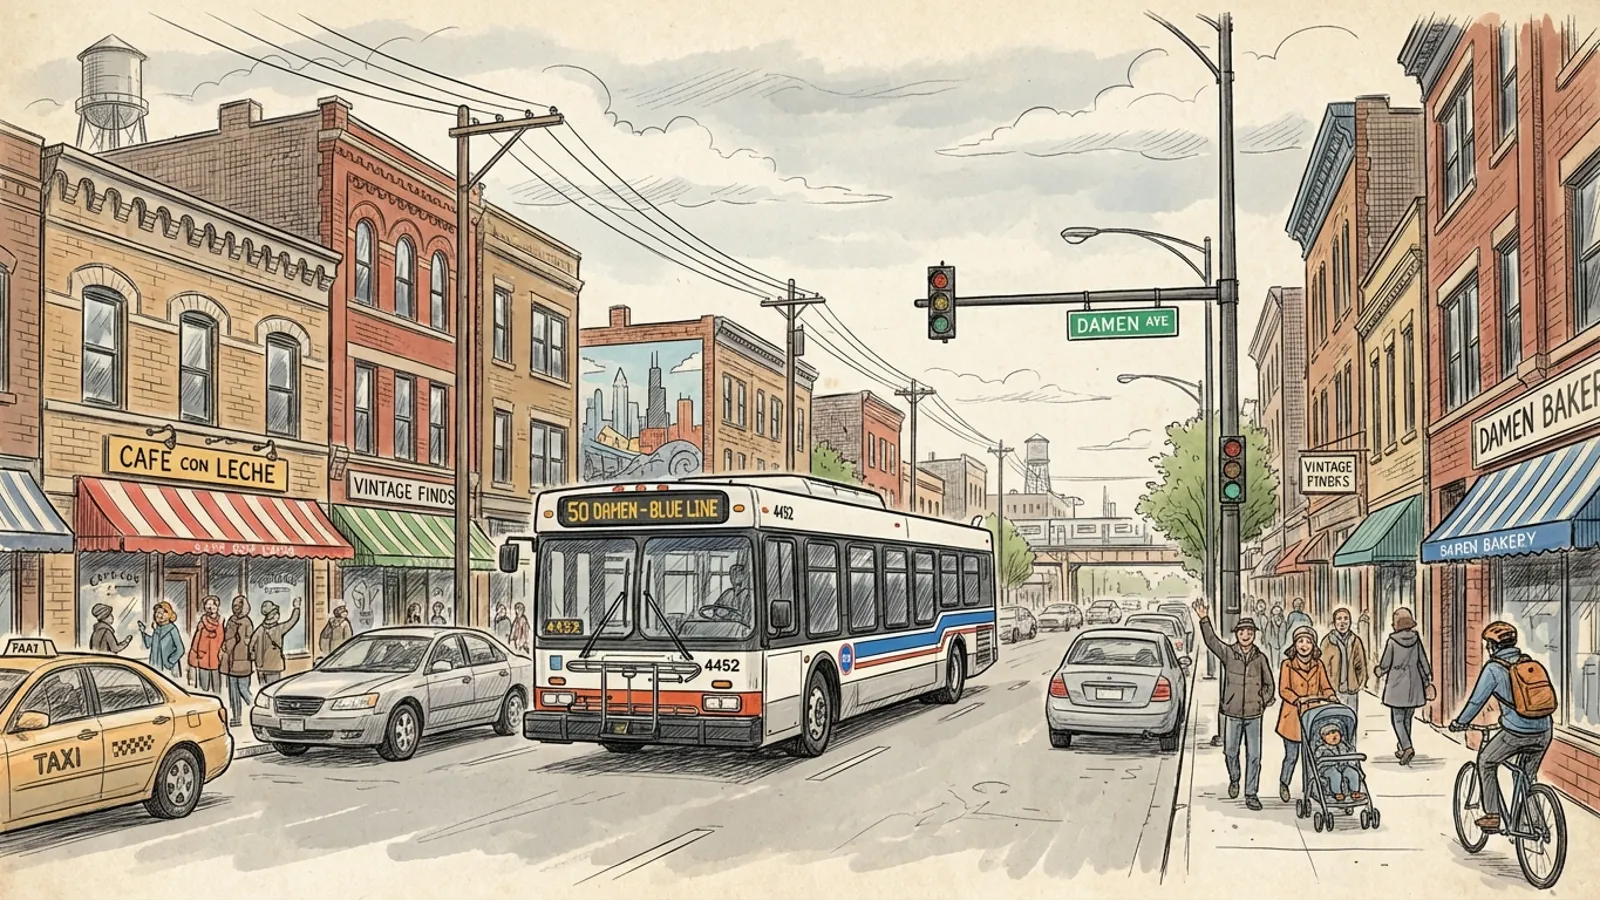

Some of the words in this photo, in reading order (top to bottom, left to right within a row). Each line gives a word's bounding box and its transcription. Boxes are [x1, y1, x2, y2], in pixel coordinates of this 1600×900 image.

[1077, 315, 1139, 334] DAMEN
[1480, 401, 1534, 455] DAMEN
[119, 444, 172, 472] CAFE
[180, 456, 208, 473] CON
[216, 457, 275, 484] LECHE
[1304, 460, 1353, 473] VINTAGE
[353, 476, 412, 500] VINTAGE
[418, 485, 455, 505] FINDS
[567, 501, 589, 522] 50
[649, 500, 683, 519] BLUE
[687, 498, 719, 518] LINE
[704, 658, 741, 672] 4452
[33, 746, 81, 775] TAXI
